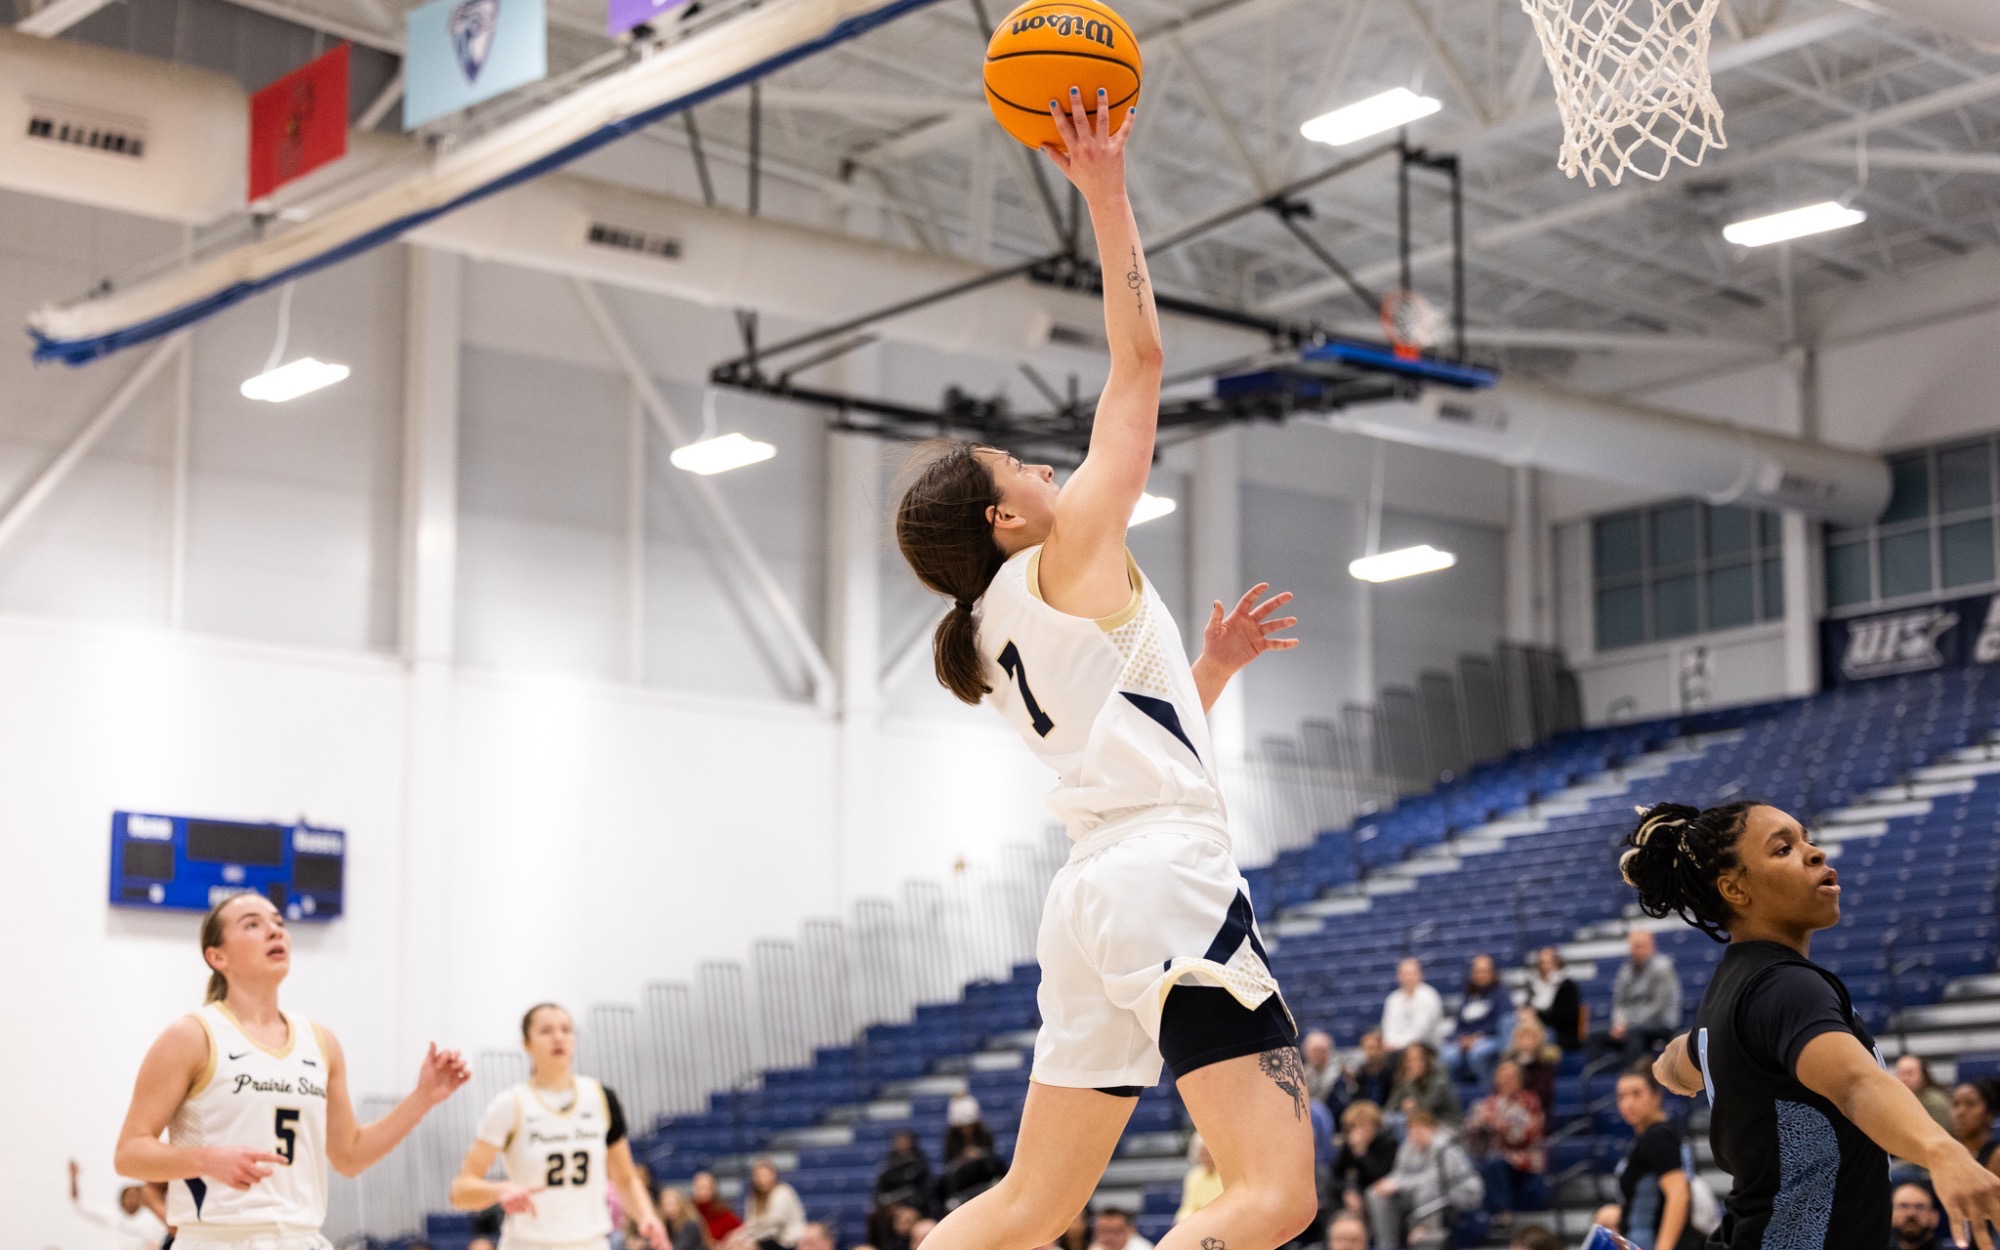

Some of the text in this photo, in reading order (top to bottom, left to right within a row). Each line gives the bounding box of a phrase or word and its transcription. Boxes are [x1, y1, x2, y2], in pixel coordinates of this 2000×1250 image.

[1011, 13, 1115, 49] Wilson
[996, 638, 1055, 739] 7
[232, 1074, 293, 1094] Prairie
[275, 1107, 301, 1166] 5
[546, 1151, 590, 1187] 23
